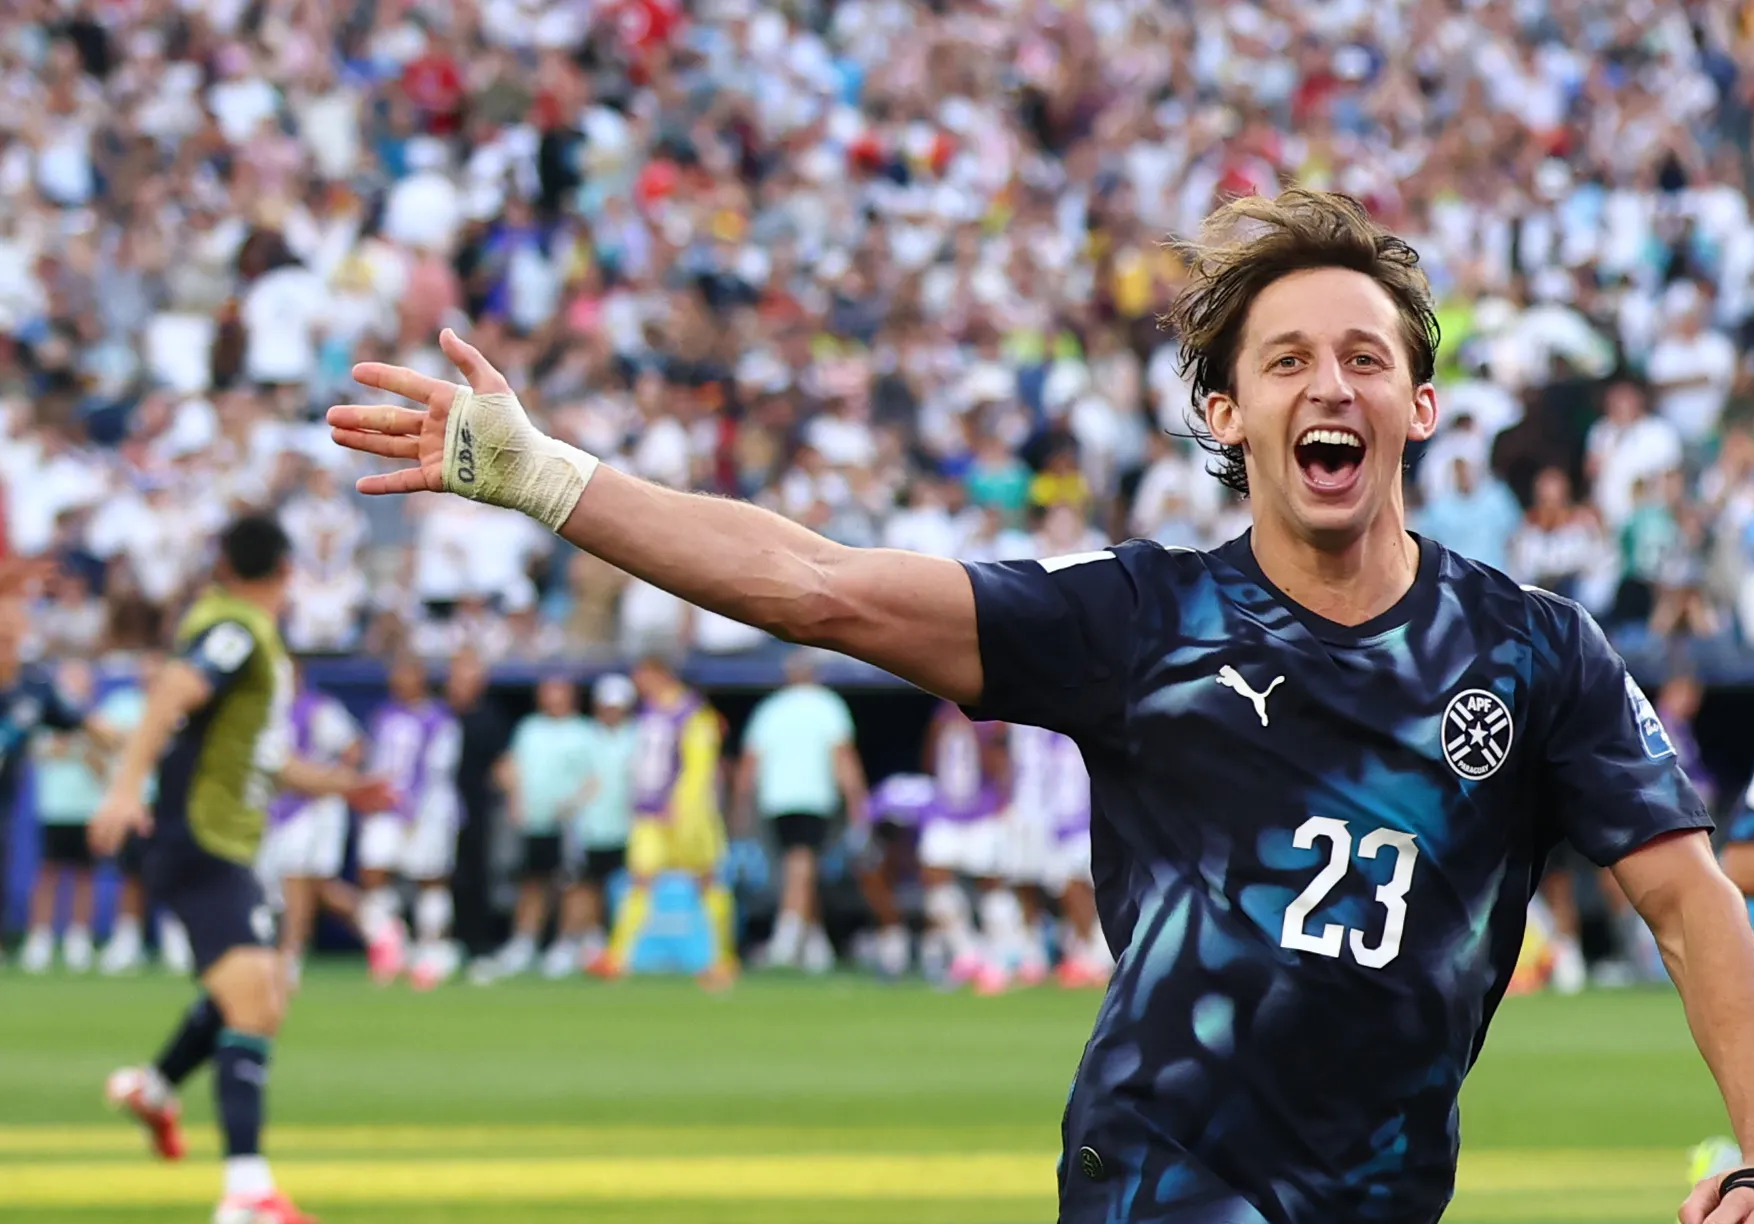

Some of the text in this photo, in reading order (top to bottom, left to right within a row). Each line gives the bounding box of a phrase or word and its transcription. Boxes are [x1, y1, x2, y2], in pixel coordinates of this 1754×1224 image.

[1467, 696, 1493, 713] APF
[1457, 760, 1489, 775] PARAGUAY
[1280, 815, 1420, 969] 23
